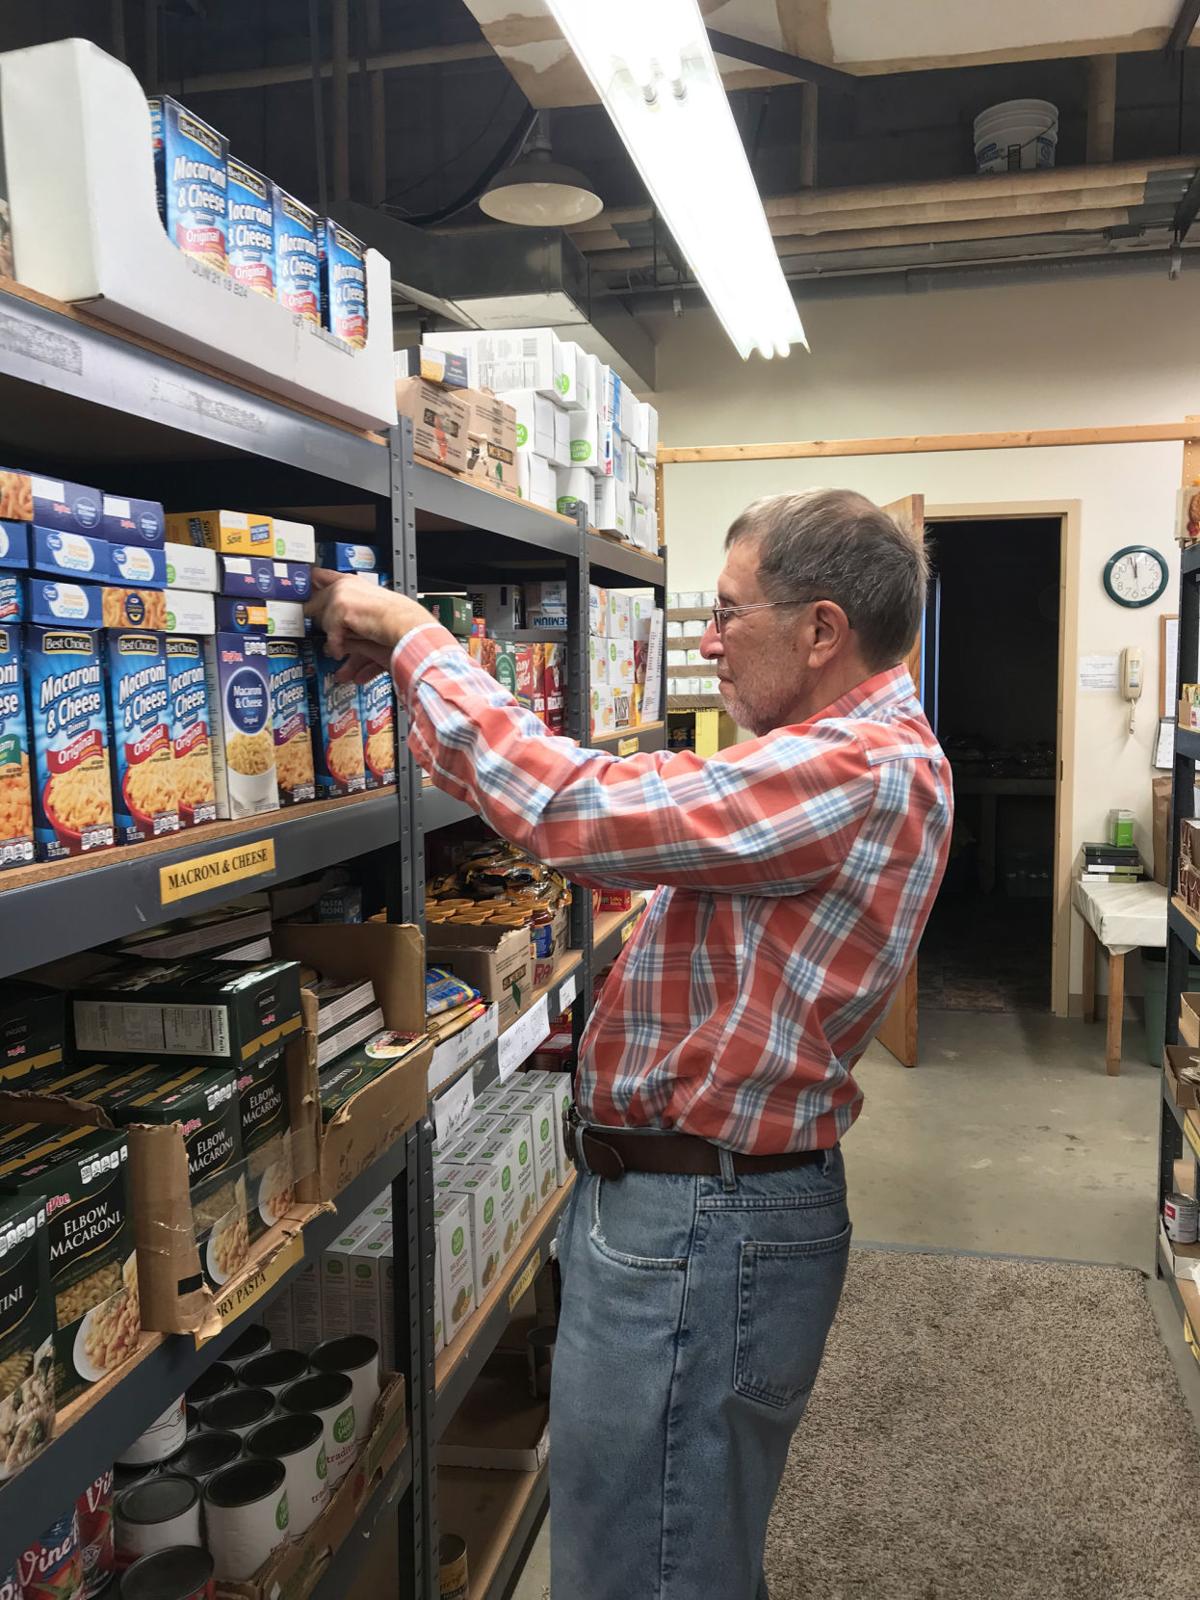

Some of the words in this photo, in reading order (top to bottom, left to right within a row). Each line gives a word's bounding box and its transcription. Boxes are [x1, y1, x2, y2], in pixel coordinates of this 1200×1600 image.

[174, 155, 226, 189] Macaroni
[178, 187, 187, 208] &
[188, 184, 225, 214] Cheese
[186, 229, 219, 246] Original
[236, 224, 272, 250] Cheese
[280, 233, 318, 257] Macaroni
[234, 265, 267, 282] Original
[289, 255, 318, 279] Cheese
[333, 263, 365, 284] Macaroni
[46, 638, 63, 650] Best
[64, 638, 91, 650] Choice
[120, 639, 135, 651] Best
[135, 640, 157, 651] Choice
[179, 643, 198, 654] Choice
[41, 659, 100, 709] Macaroni
[119, 659, 166, 705] Macaroni
[270, 660, 303, 692] Macaroni
[175, 690, 206, 718] Cheese
[233, 684, 262, 697] Macaroni
[235, 698, 242, 709] &
[242, 697, 262, 709] Cheese
[278, 685, 304, 710] Cheese
[334, 683, 356, 706] Cheese
[373, 682, 392, 702] Cheese
[47, 709, 56, 734] &
[58, 692, 101, 726] Cheese
[125, 705, 132, 728] &
[133, 690, 167, 721] Cheese
[334, 710, 353, 733] Original
[58, 730, 97, 765] Original
[134, 725, 164, 756] Original
[175, 725, 202, 751] Original
[168, 861, 220, 890] MACRONI
[221, 859, 231, 874] &
[231, 848, 268, 871] CHEESE
[242, 1091, 281, 1127] MACARONI
[250, 1083, 274, 1109] ELBOW
[196, 1127, 226, 1156] ELBOW
[188, 1136, 234, 1176] MACARONI
[64, 1201, 108, 1238] ELBOW
[50, 1210, 121, 1262] MACARONI
[236, 1271, 267, 1304] PASTA
[17, 1537, 72, 1587] Vine
